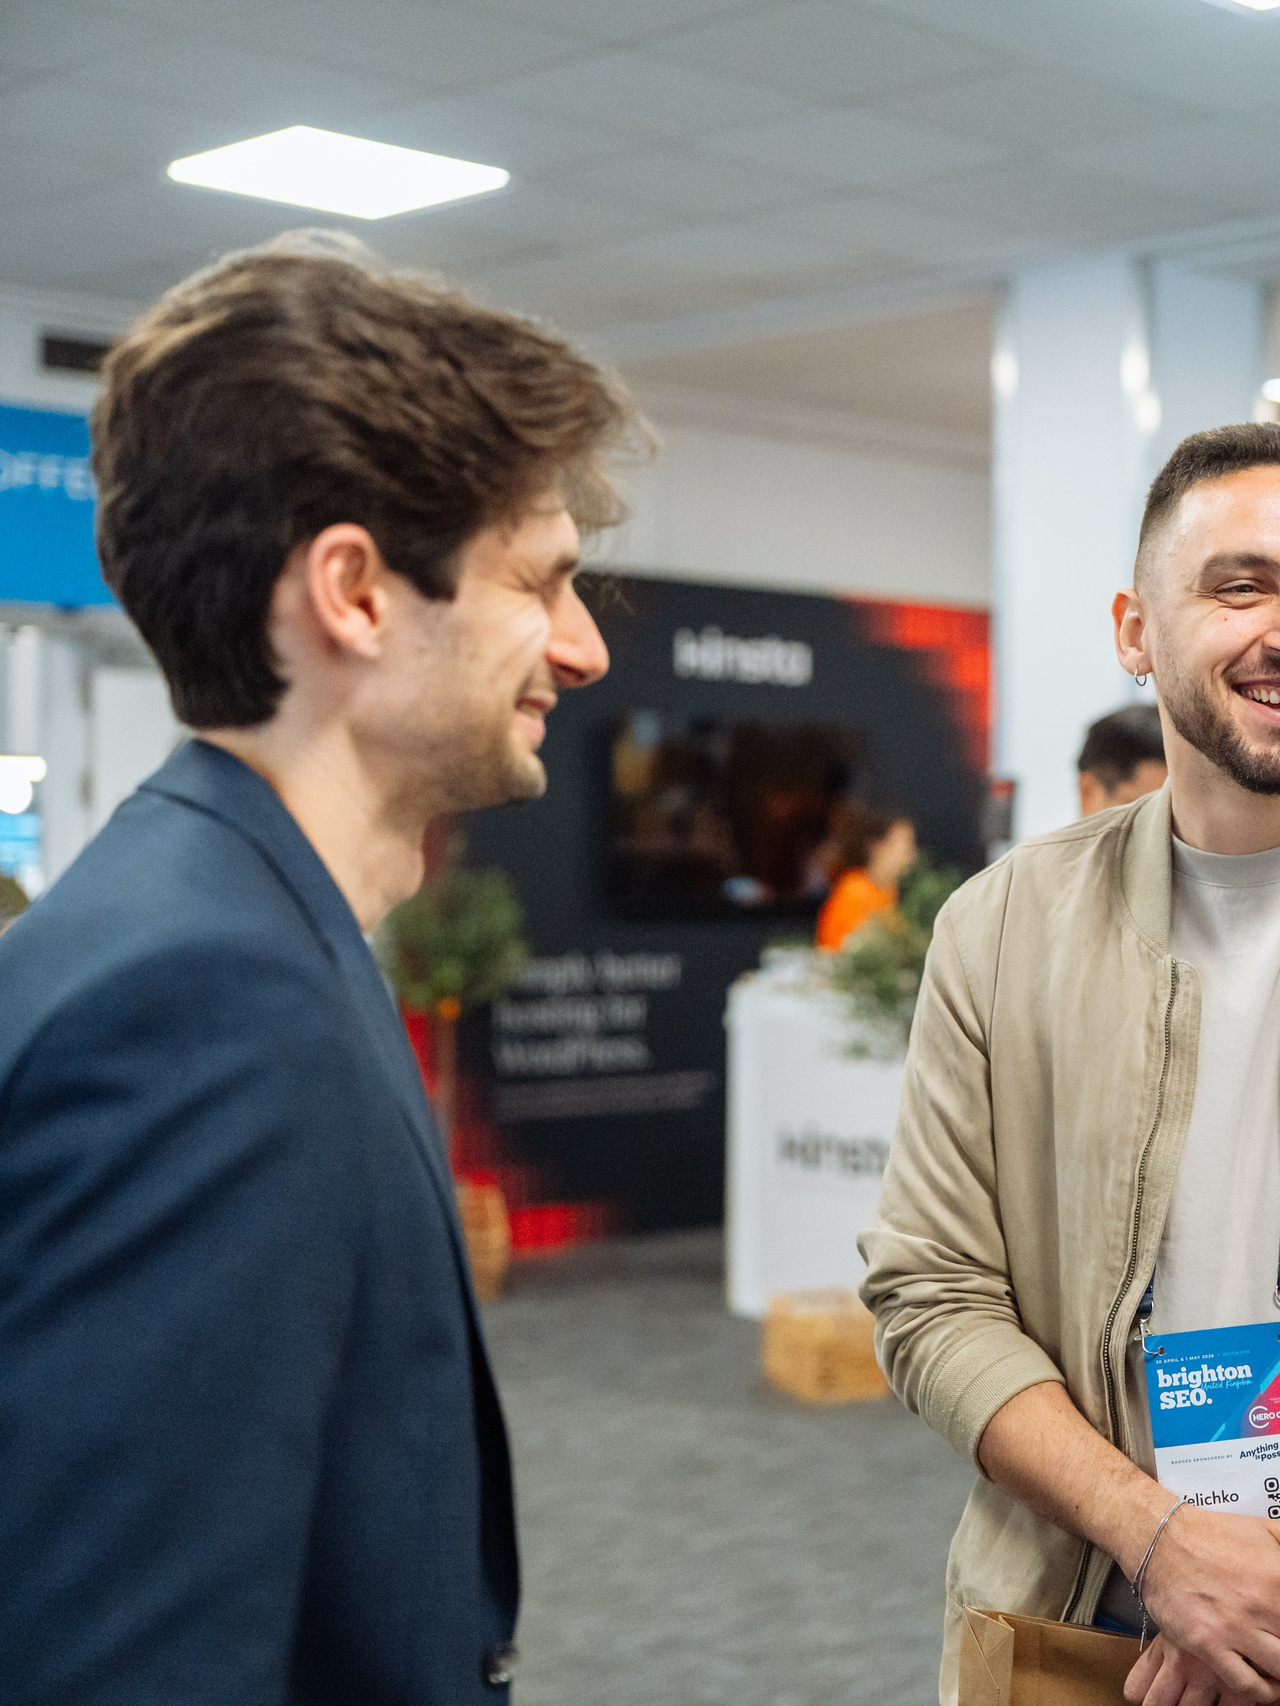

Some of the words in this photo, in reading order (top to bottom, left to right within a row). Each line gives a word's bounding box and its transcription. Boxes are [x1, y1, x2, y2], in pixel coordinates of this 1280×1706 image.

[1156, 1363, 1252, 1388] brighton
[1200, 1381, 1223, 1391] United
[1225, 1378, 1253, 1389] Kingdom
[1160, 1388, 1213, 1410] SEO.
[1252, 1412, 1275, 1422] HERO
[1239, 1442, 1279, 1459] Anything
